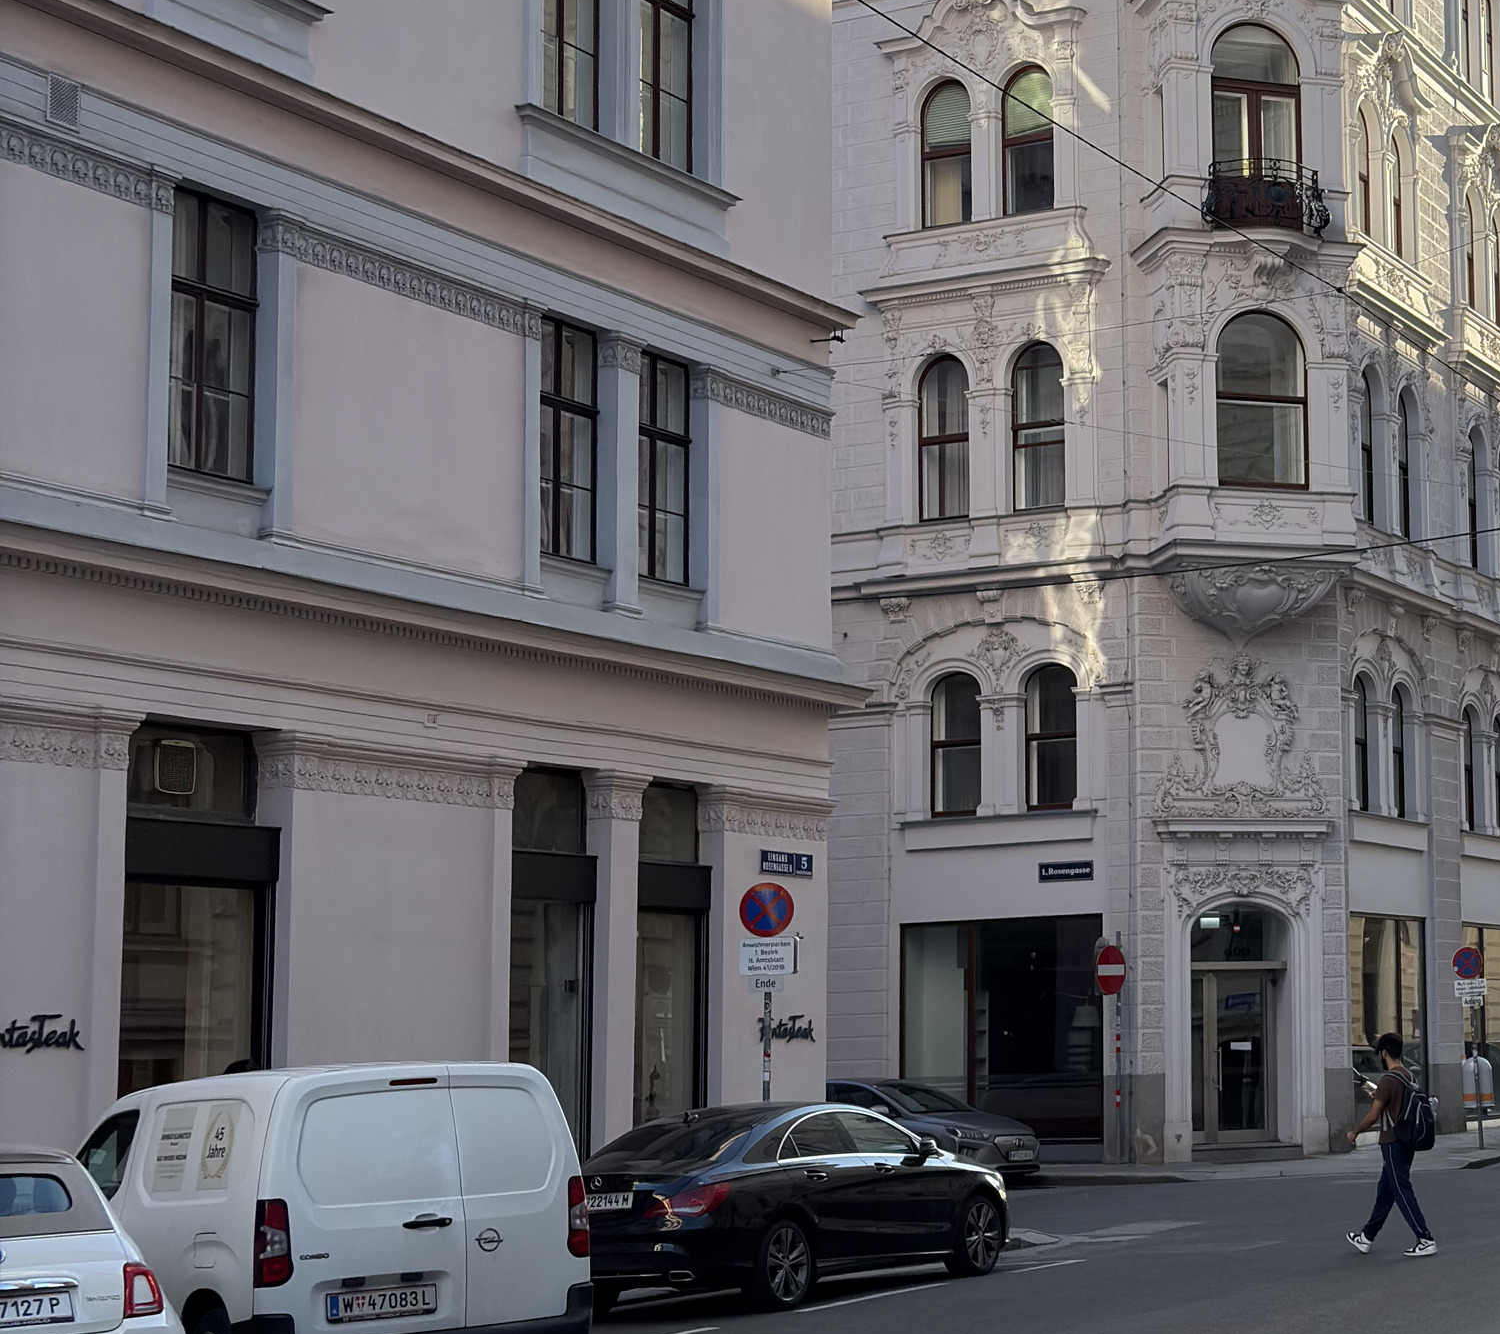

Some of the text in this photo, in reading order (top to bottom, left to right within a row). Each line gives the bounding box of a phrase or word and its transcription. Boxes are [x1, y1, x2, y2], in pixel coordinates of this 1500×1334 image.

[801, 857, 808, 869] 5
[1048, 867, 1091, 875] Rosengasse
[755, 978, 776, 988] Ende
[215, 1127, 225, 1141] 45
[206, 1144, 226, 1158] Jahre
[590, 1194, 629, 1207] 22144 M
[342, 1289, 430, 1313] W 47083 L
[0, 1297, 60, 1319] 7127 P
